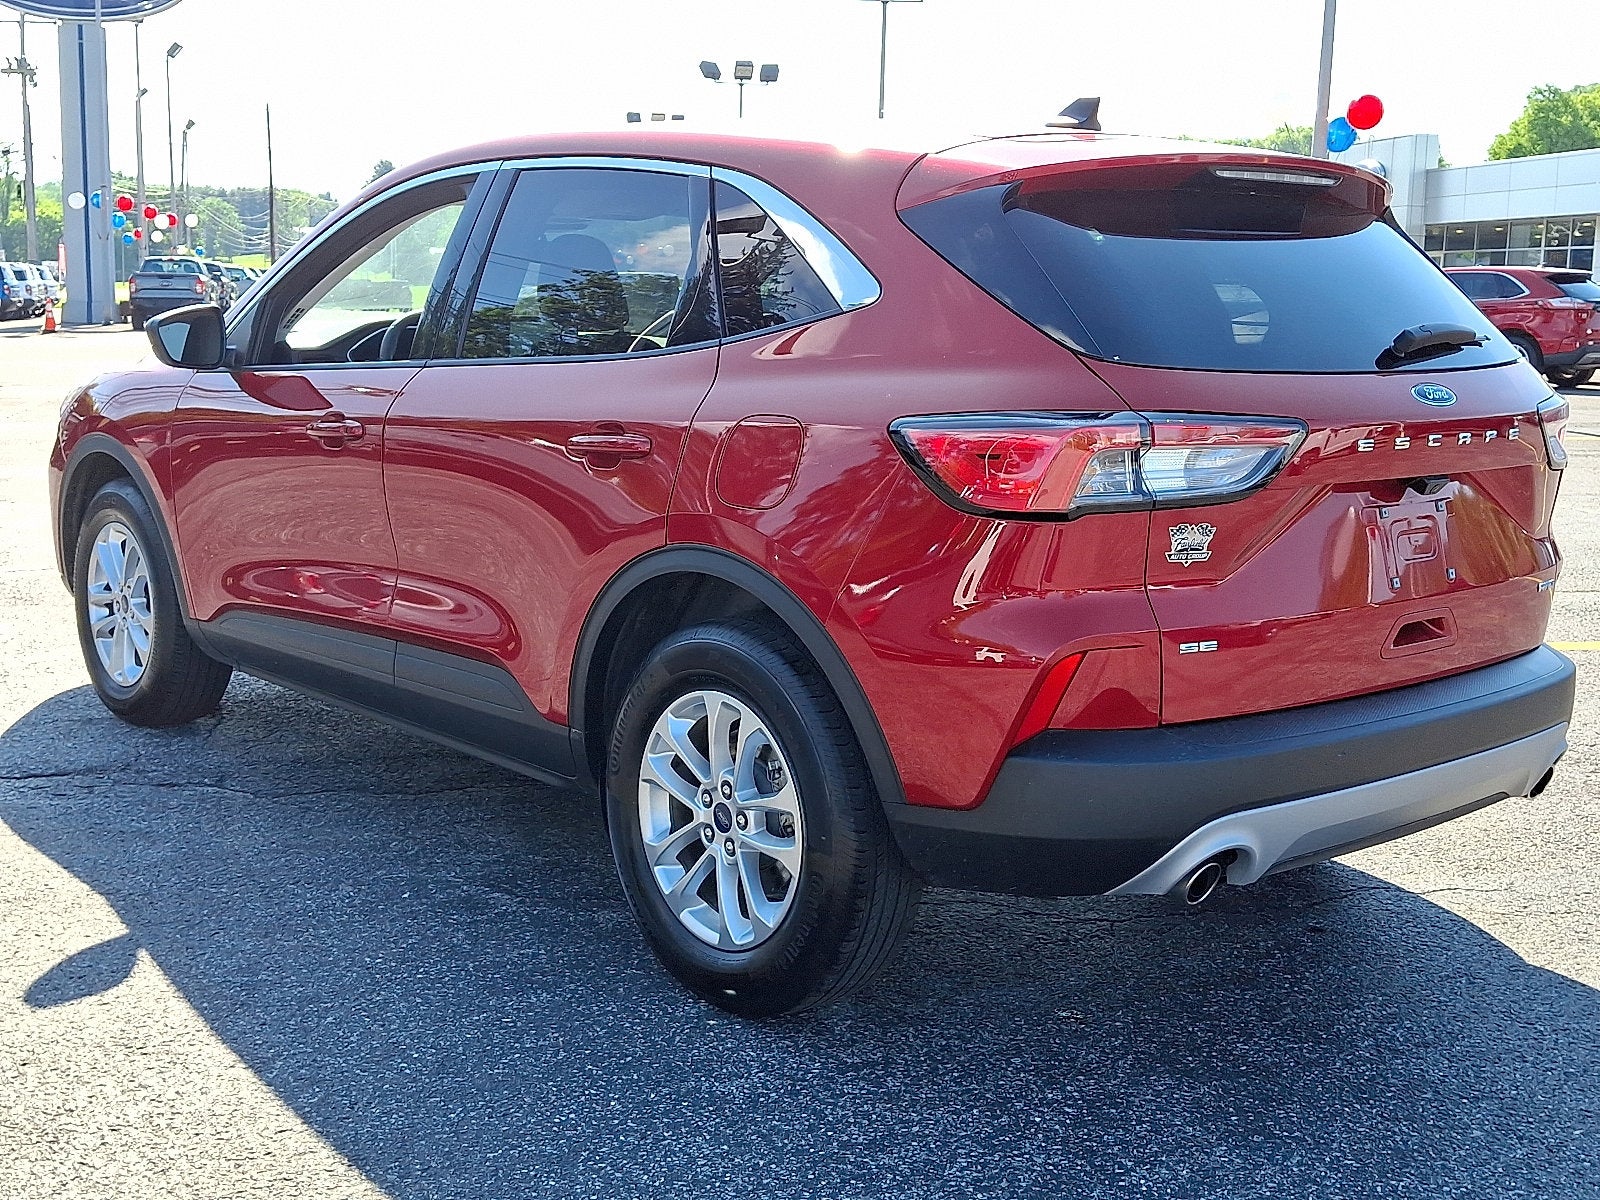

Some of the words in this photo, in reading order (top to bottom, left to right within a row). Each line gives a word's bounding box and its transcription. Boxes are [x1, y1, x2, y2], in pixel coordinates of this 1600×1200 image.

[1423, 385, 1449, 400] Ford
[1357, 427, 1520, 452] ESCAPE
[1187, 552, 1208, 560] GROUP
[1179, 640, 1218, 655] SE
